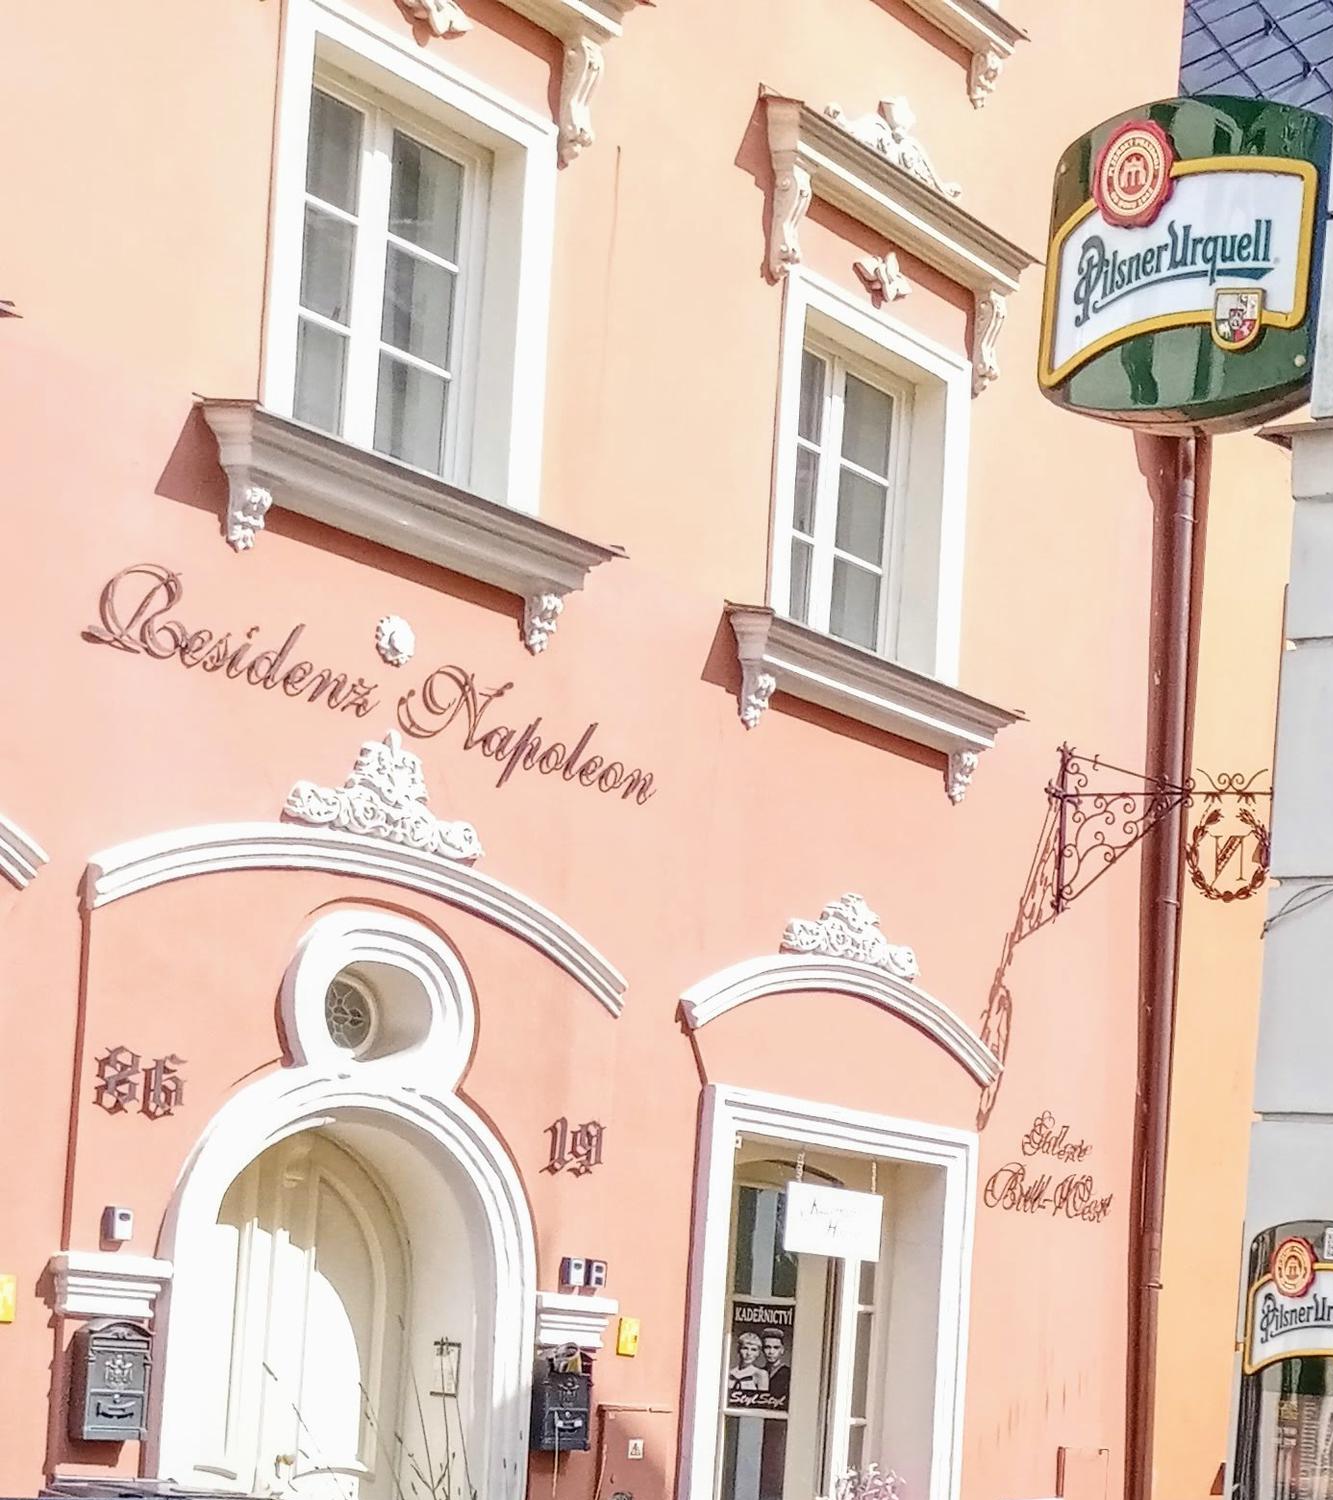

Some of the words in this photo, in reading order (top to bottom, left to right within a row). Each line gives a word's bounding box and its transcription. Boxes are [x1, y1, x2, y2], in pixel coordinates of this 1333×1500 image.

[1074, 235, 1169, 327] Pilsner
[1167, 220, 1272, 285] Urquell
[81, 563, 380, 718] Residenz
[397, 665, 658, 805] Napoleon
[539, 1116, 607, 1178] 19
[735, 1306, 793, 1325] KADEŘNICTVÍ
[1260, 1293, 1316, 1344] Pilsner
